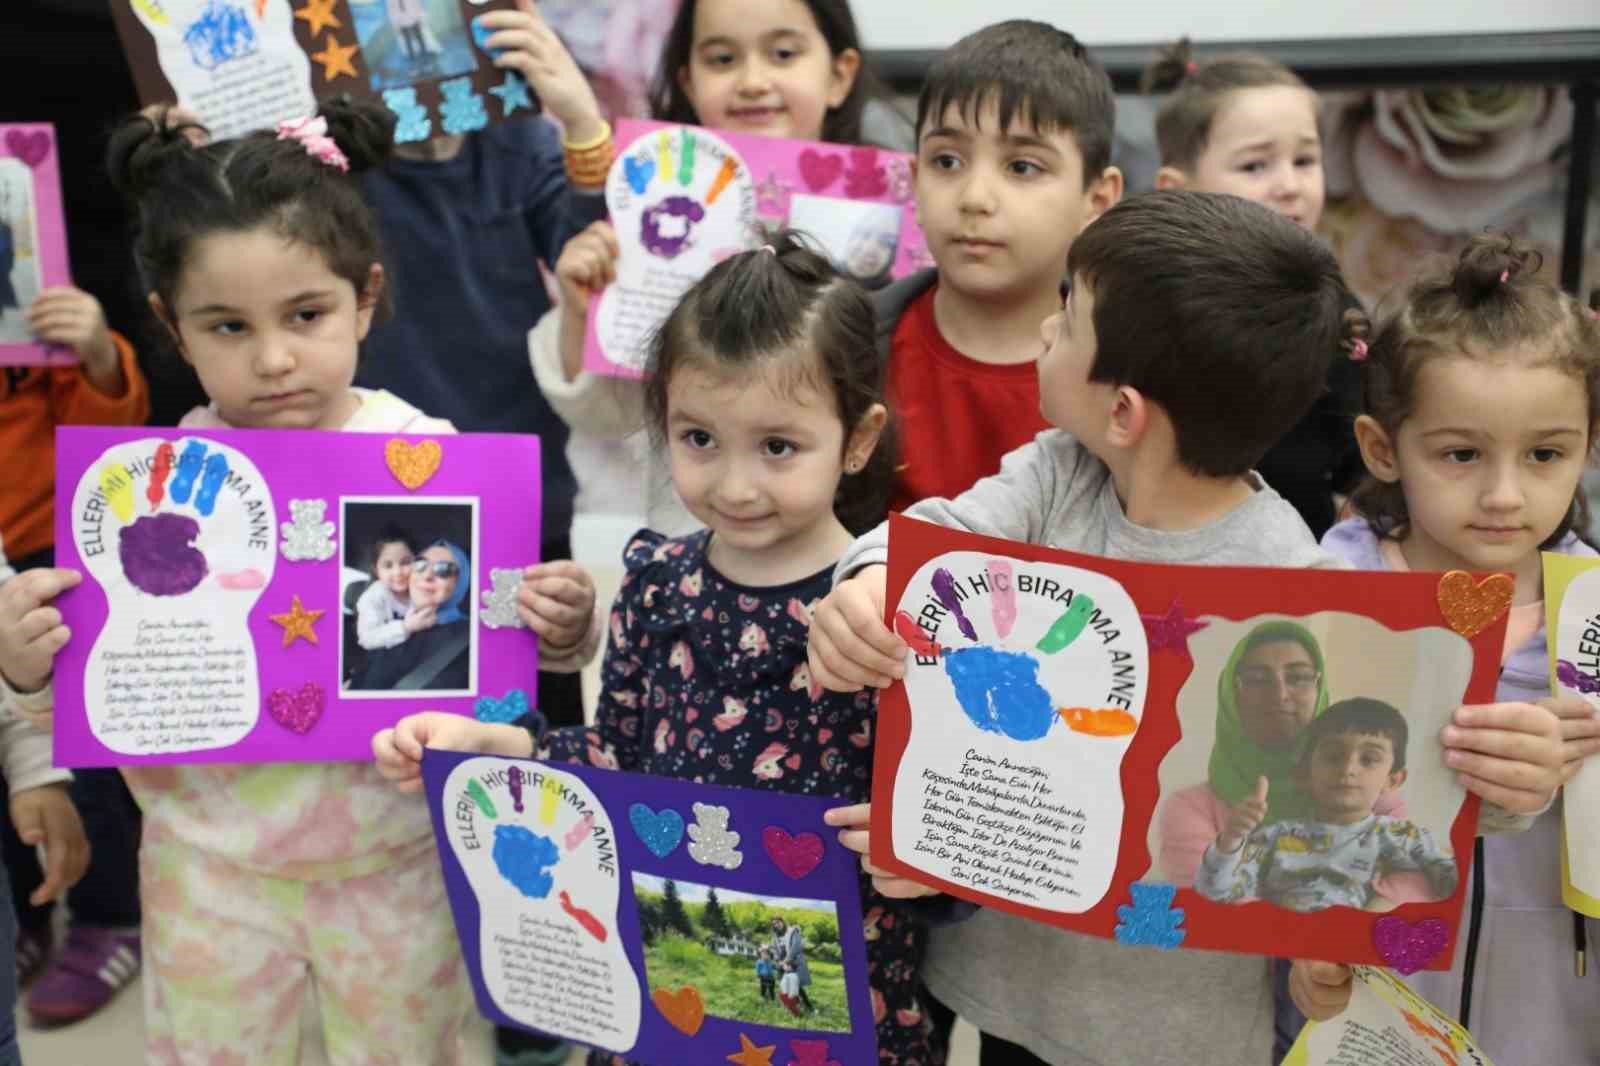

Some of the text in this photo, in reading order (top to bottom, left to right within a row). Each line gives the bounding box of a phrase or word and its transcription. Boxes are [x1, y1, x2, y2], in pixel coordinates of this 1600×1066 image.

[1017, 574, 1121, 645] BIRAMA
[1106, 649, 1136, 710] ANNE
[591, 826, 615, 879] ANNE
